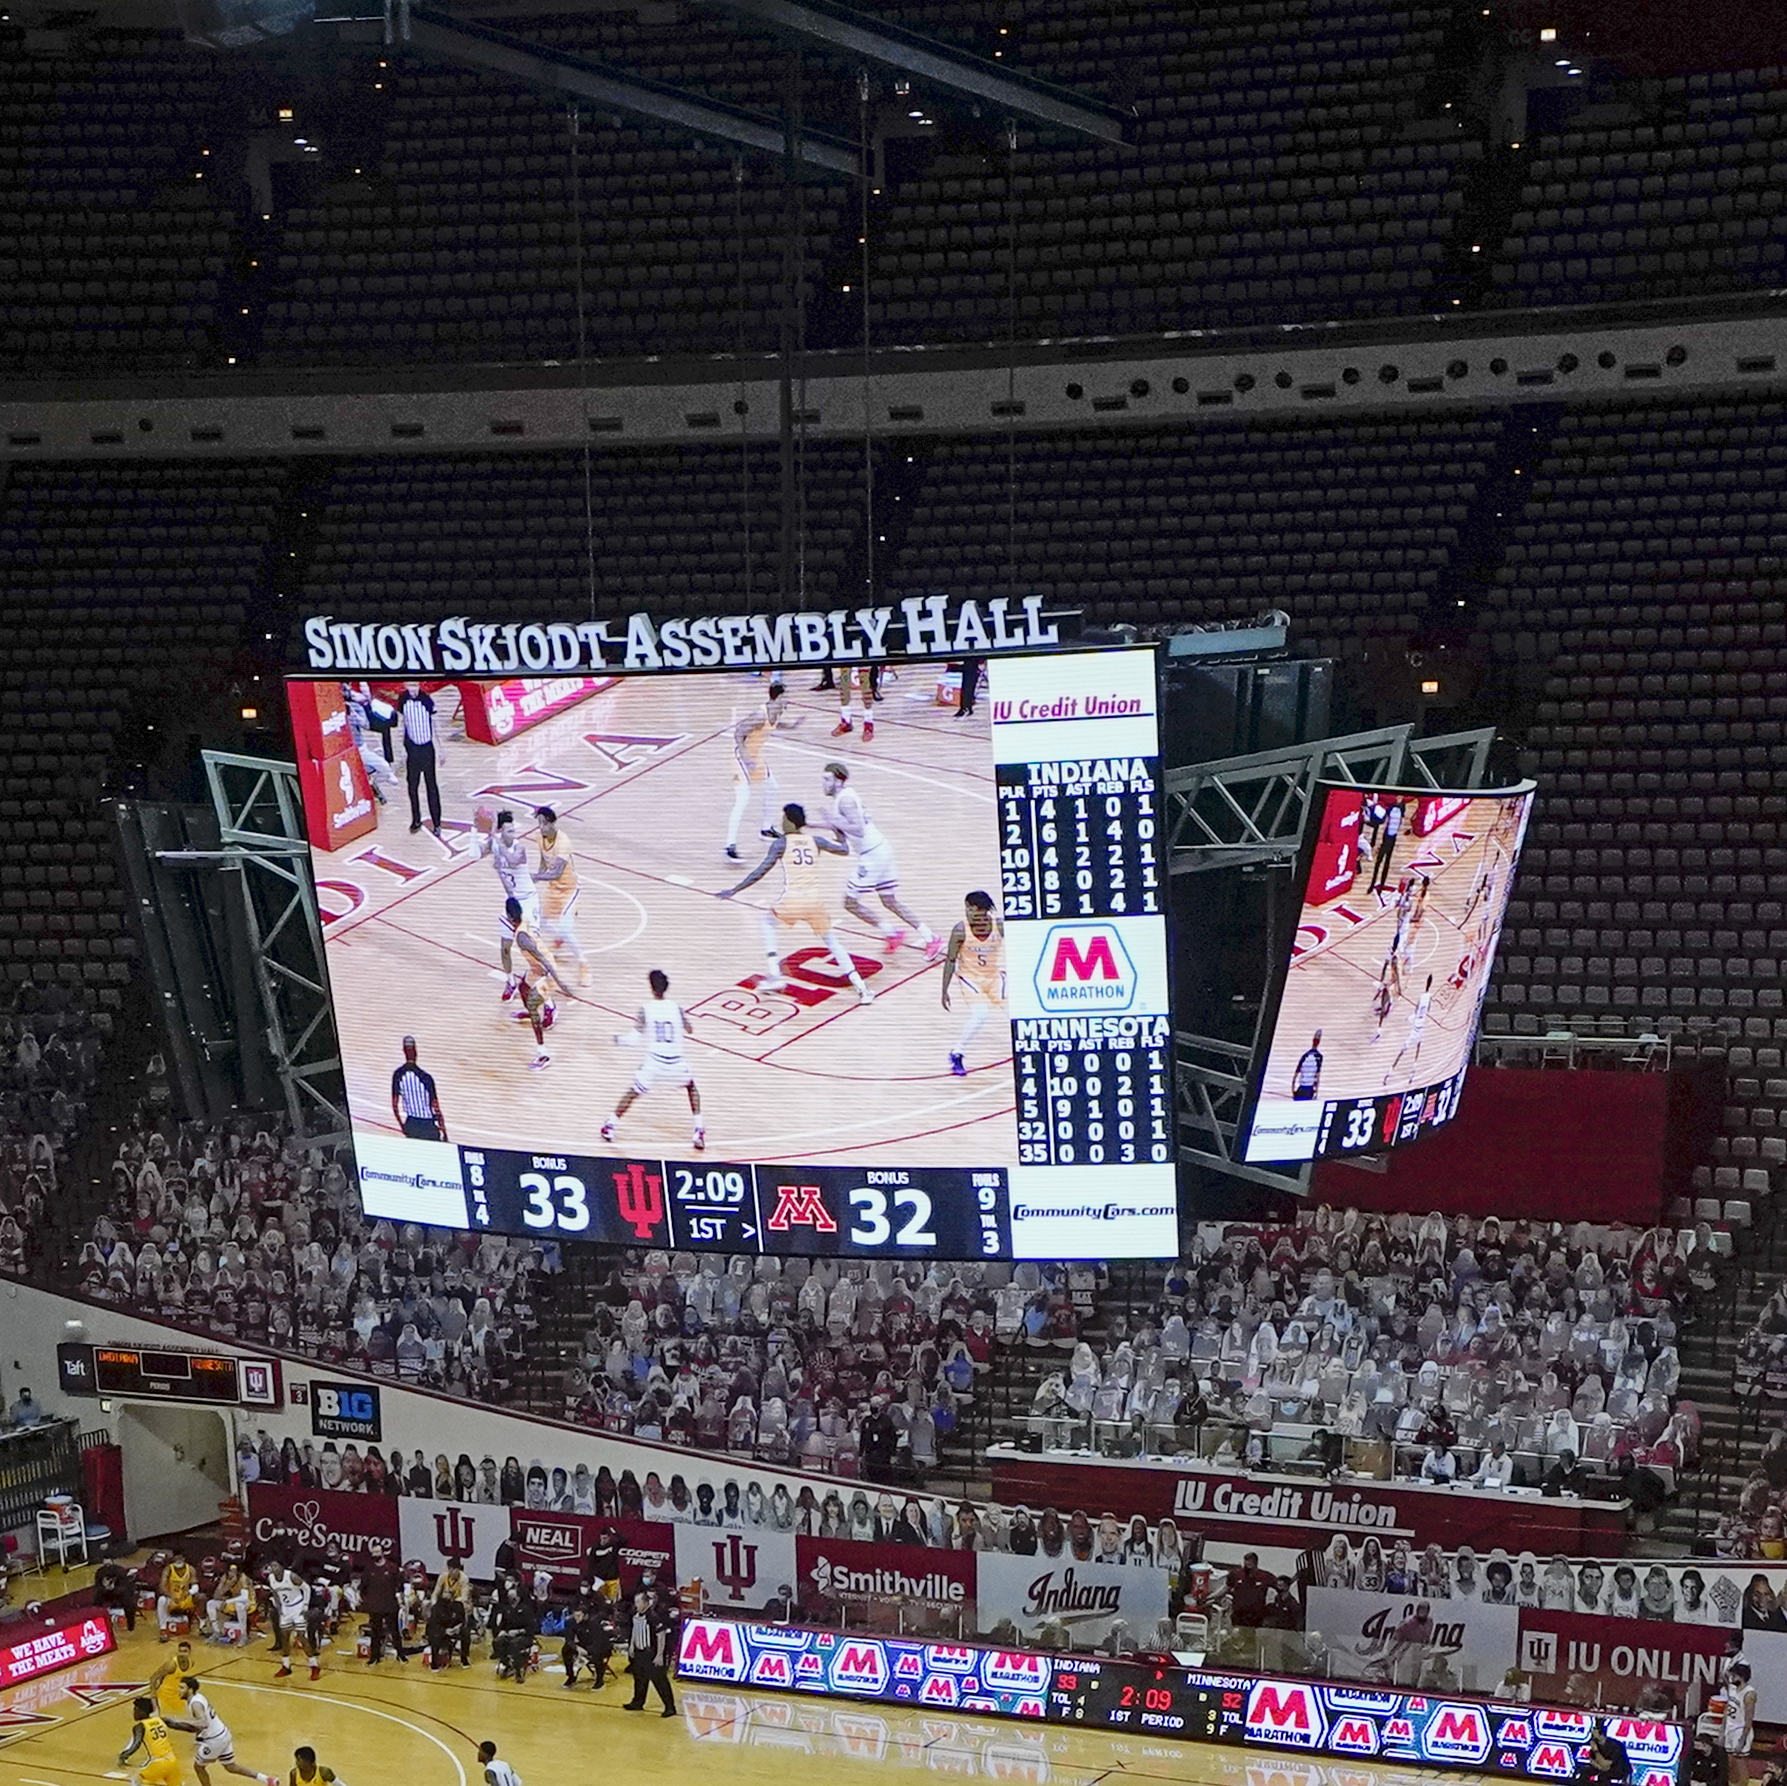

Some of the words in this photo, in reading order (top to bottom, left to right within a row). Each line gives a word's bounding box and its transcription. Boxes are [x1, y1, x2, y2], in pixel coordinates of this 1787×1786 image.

[304, 616, 436, 671] SIMON
[438, 617, 612, 671] SKJODT
[624, 607, 893, 668] ASSEMBLY
[901, 594, 1059, 655] HALL
[994, 701, 1012, 721] IU
[1019, 696, 1078, 720] Credit
[1084, 694, 1141, 715] Union
[1027, 758, 1149, 786] INDIANA
[999, 785, 1025, 800] PLR
[1033, 784, 1058, 799] PTS
[1065, 782, 1091, 797] AST
[1096, 781, 1125, 795] REB
[1130, 779, 1155, 793] FLS
[1047, 985, 1125, 1001] MARATHON
[1017, 1015, 1171, 1040] MINNESOTA
[532, 1156, 567, 1171] BONUS
[360, 1166, 462, 1191] CommunityCars.com
[675, 1169, 745, 1203] 2:09
[866, 1171, 910, 1186] BONUS
[972, 1172, 1000, 1188] FOULS
[519, 1172, 590, 1232] 33
[768, 1185, 837, 1233] M
[1013, 1203, 1175, 1221] CommunityCars.com
[688, 1218, 727, 1240] 1ST
[848, 1187, 938, 1247] 32
[65, 1360, 86, 1377] Taft
[319, 1418, 376, 1434] NETWORK
[1175, 1479, 1207, 1511] IU
[1213, 1483, 1303, 1519] Credit
[1311, 1489, 1397, 1528] Union
[526, 1527, 574, 1547] NEAL
[618, 1547, 670, 1560] COOPER
[833, 1565, 965, 1601] Smithville
[1022, 1567, 1121, 1617] Indiana
[1355, 1604, 1466, 1655] Inna
[11, 1639, 33, 1659] WE
[34, 1631, 67, 1653] HAVE
[8, 1658, 33, 1678] THE
[34, 1644, 77, 1671] MEATS
[1567, 1641, 1600, 1673] IU
[1611, 1646, 1719, 1685] ONLIN
[1053, 1659, 1101, 1674] INDIANA
[1187, 1673, 1252, 1690] MINNESOTA
[1120, 1685, 1172, 1711] 2:09
[1109, 1710, 1131, 1723] 1ST
[1141, 1713, 1184, 1729] PERIOD
[150, 1725, 168, 1741] 35
[1245, 1726, 1312, 1745] MARATHON
